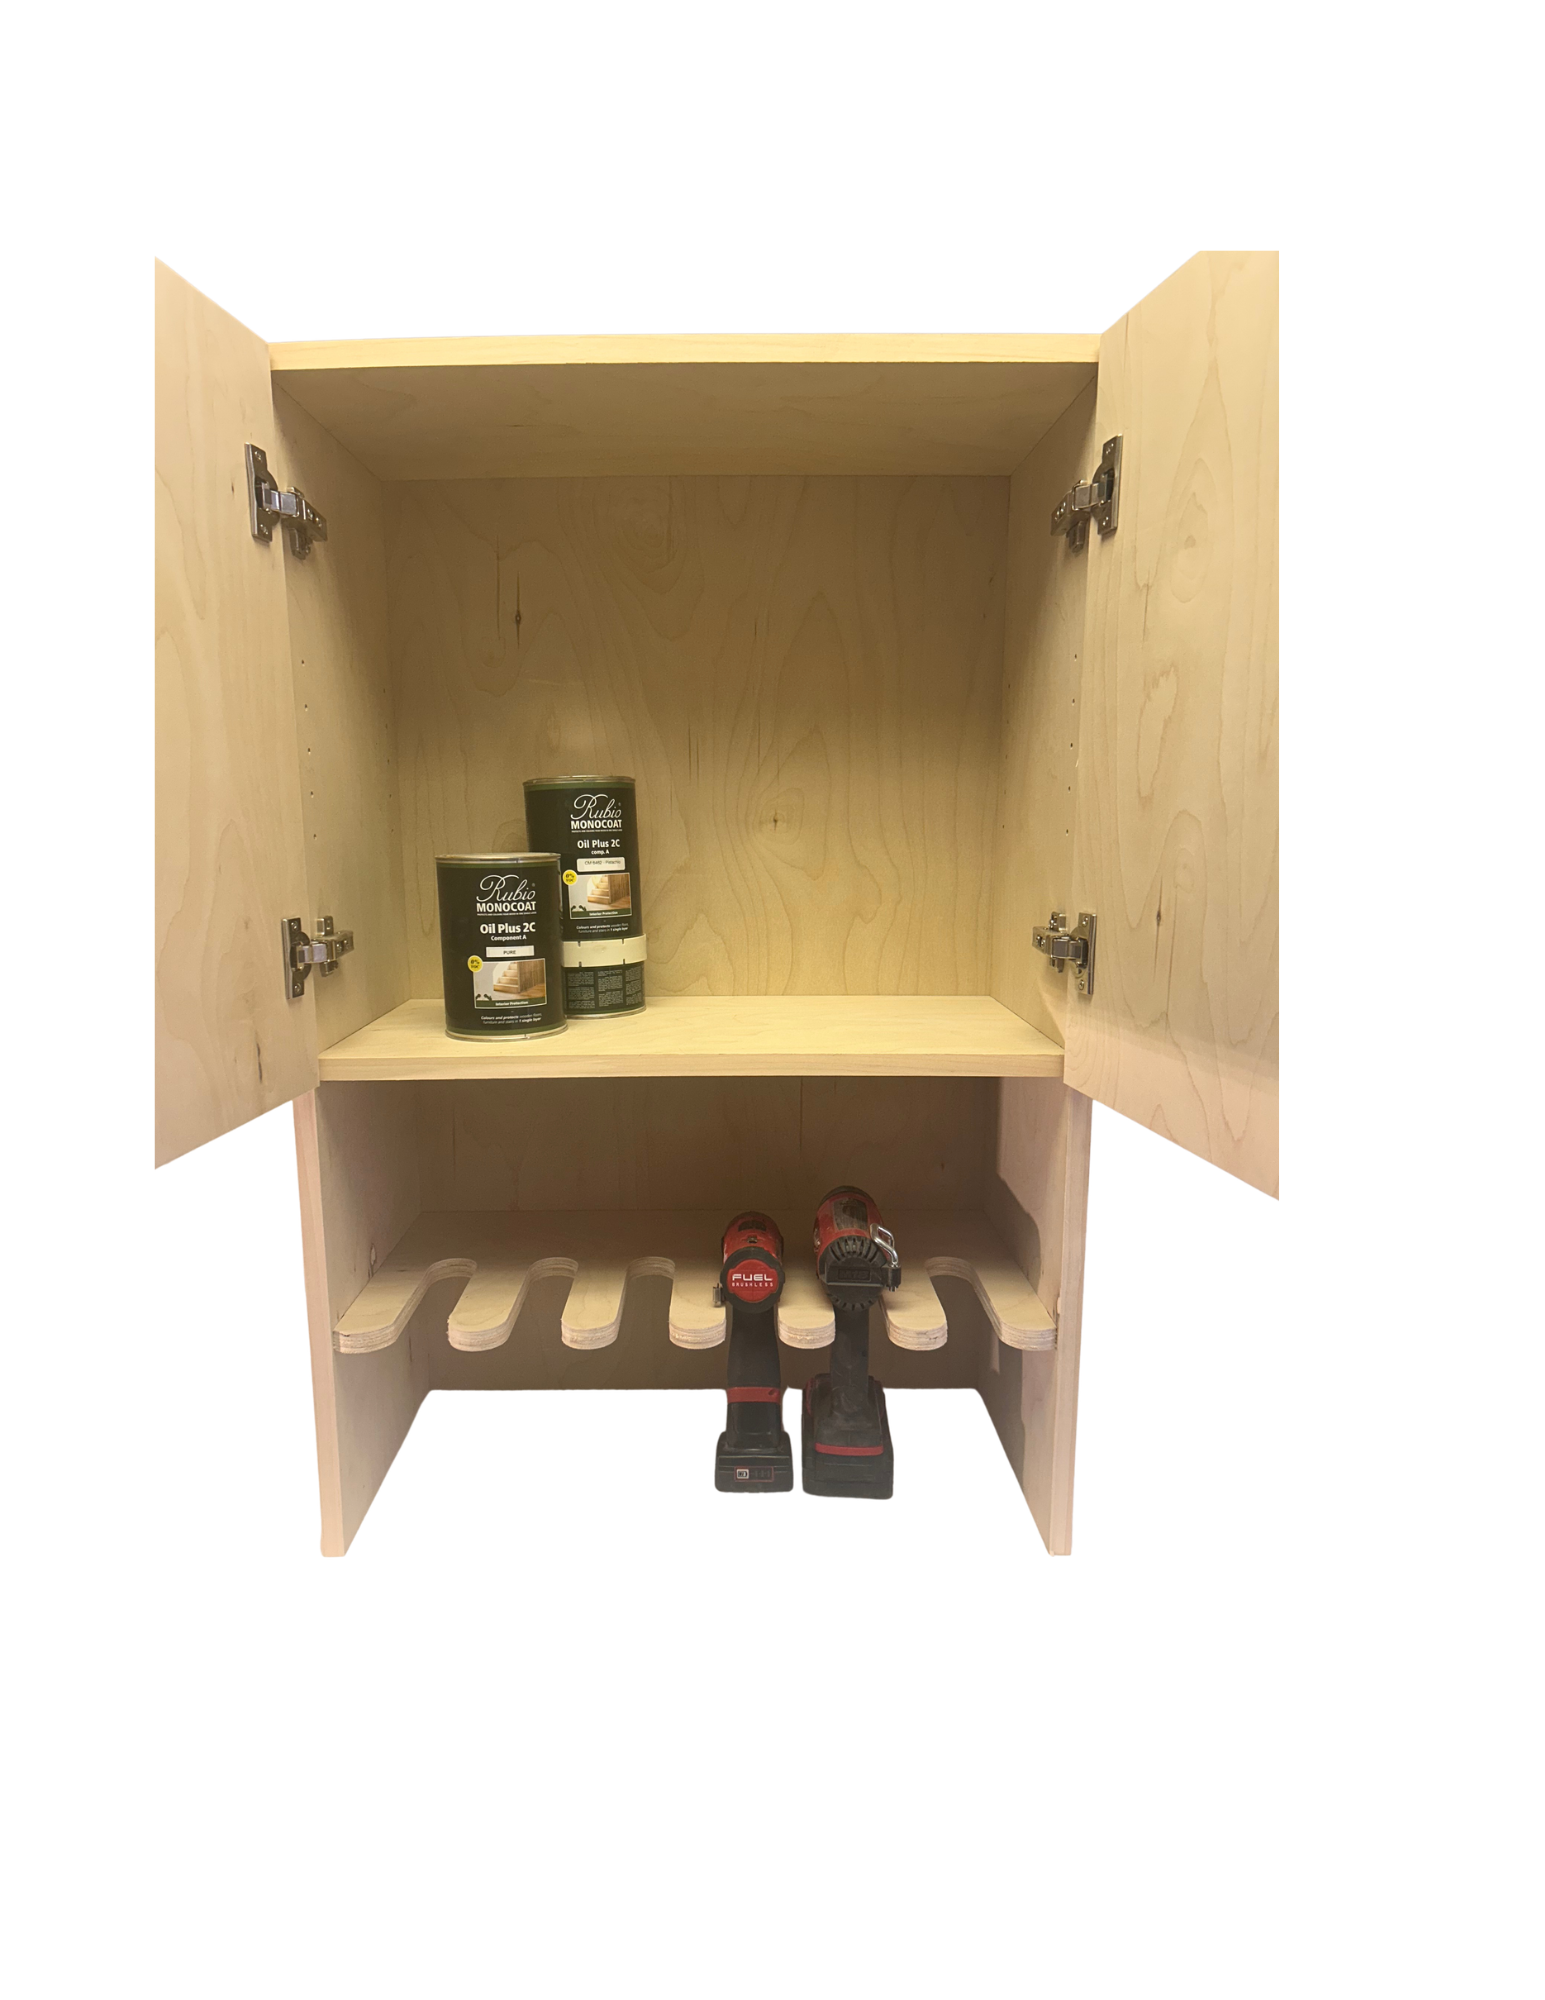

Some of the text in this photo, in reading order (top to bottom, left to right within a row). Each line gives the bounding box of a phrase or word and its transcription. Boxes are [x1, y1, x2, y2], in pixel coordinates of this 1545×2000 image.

[571, 794, 622, 820] Rubio
[570, 820, 622, 830] MONOCOAT
[577, 839, 620, 849] Oil Plus 2C
[476, 874, 536, 902] Rubio
[476, 901, 536, 912] MONOCOAT
[480, 922, 536, 934] Oil Plus 2C
[732, 1273, 774, 1281] FUEL
